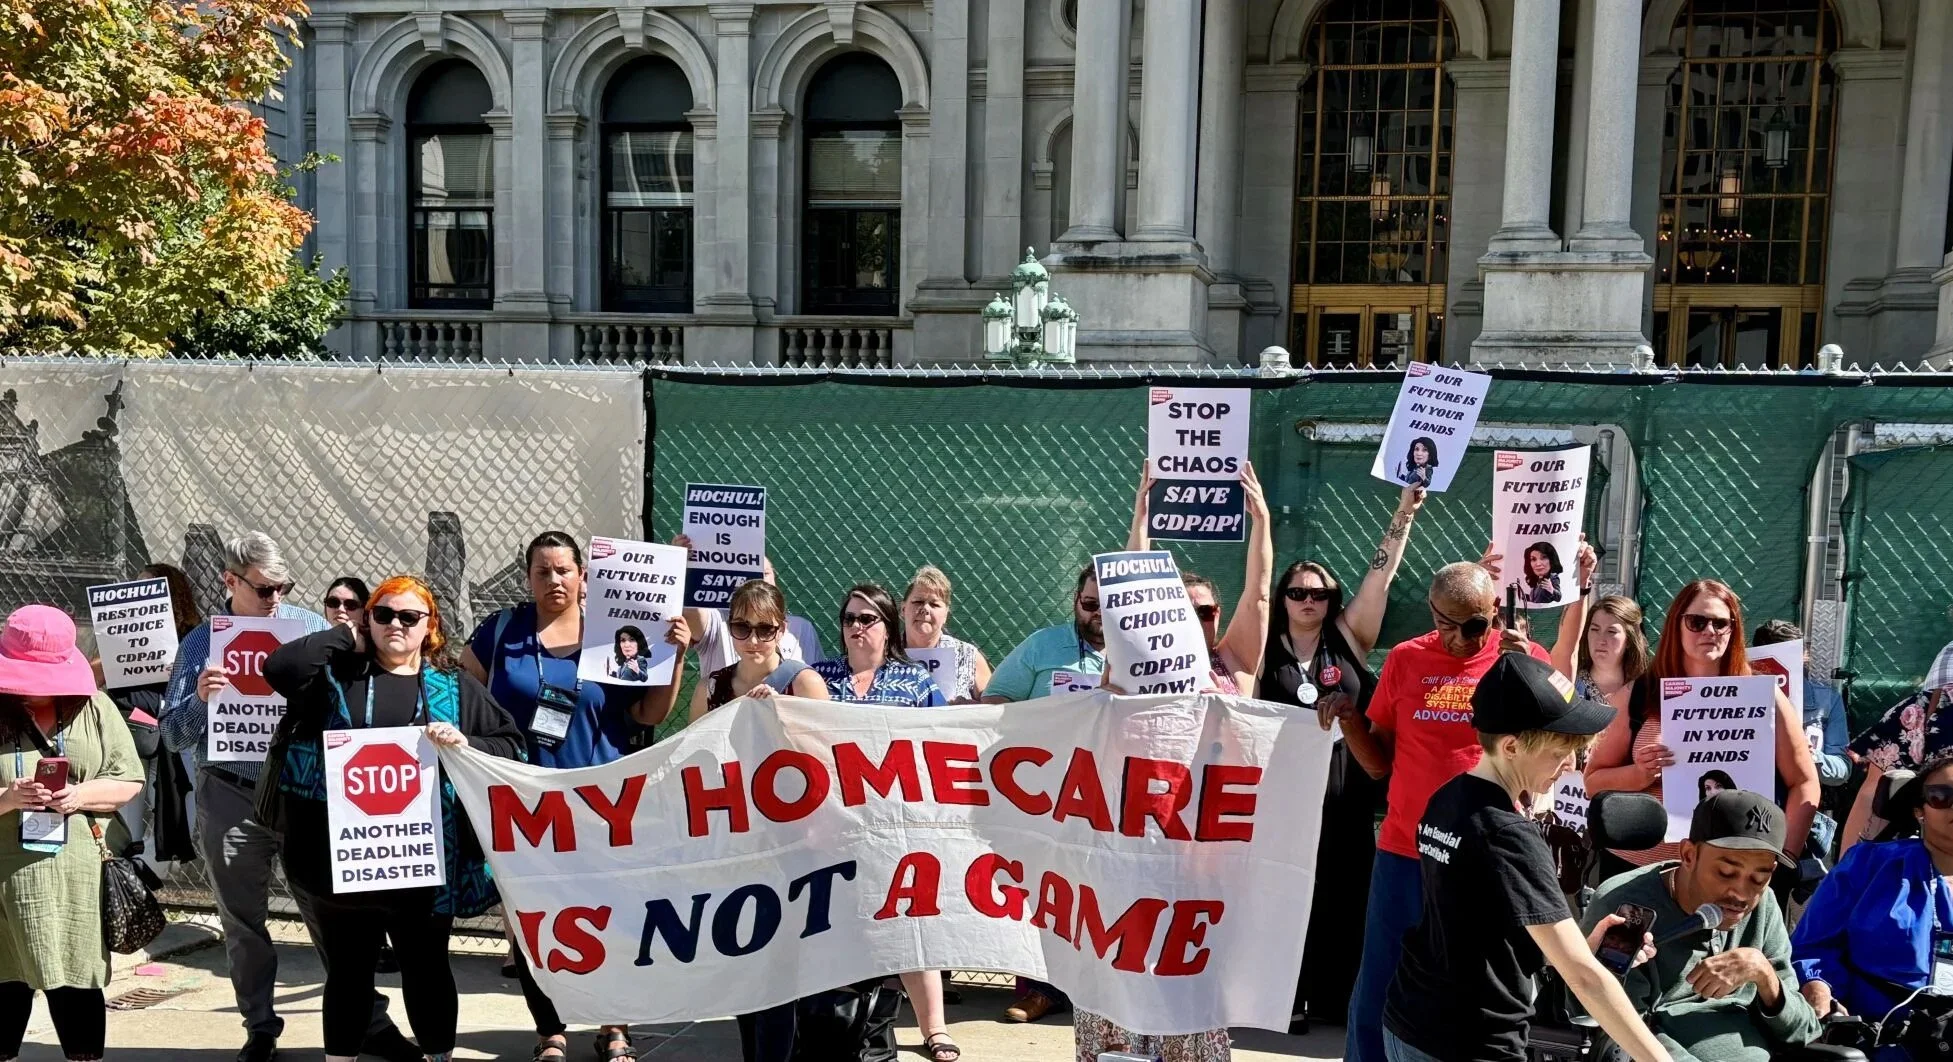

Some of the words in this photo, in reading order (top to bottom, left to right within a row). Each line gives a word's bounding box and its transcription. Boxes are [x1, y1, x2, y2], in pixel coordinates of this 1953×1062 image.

[1434, 373, 1463, 387] OUR
[1407, 385, 1464, 405] FUTURE
[1462, 395, 1478, 406] IS
[1168, 402, 1230, 419] STOP
[1410, 402, 1426, 414] IN
[1428, 407, 1465, 421] YOUR
[1408, 419, 1455, 436] HANDS
[1176, 429, 1221, 446] THE
[1157, 455, 1238, 473] CHAOS
[1531, 459, 1565, 473] OUR
[1502, 479, 1568, 492] FUTURE
[1570, 477, 1582, 489] IS
[689, 489, 764, 506] HOCHUL!
[1163, 486, 1230, 504] SAVE
[1511, 502, 1530, 514] IN
[1534, 499, 1574, 514] YOUR
[689, 511, 760, 528] ENOUGH
[1151, 513, 1242, 532] CDPAP!
[1515, 521, 1570, 535] HANDS
[716, 532, 731, 545] IS
[622, 552, 655, 565] OUR
[689, 550, 760, 566] ENOUGH
[596, 569, 660, 585] FUTURE
[660, 575, 677, 586] IS
[702, 574, 747, 587] SAVE
[92, 583, 166, 603] HOCHUL!
[604, 588, 622, 600] IN
[624, 590, 667, 604] YOUR
[693, 590, 733, 604] CDP
[1106, 586, 1185, 609] RESTORE
[97, 603, 168, 622] RESTORE
[607, 607, 662, 622] HANDS
[1119, 608, 1187, 631] CHOICE
[107, 619, 164, 636] CHOICE
[128, 636, 150, 648] TO
[1148, 633, 1174, 651] TO
[116, 650, 167, 664] CDPAP
[227, 650, 267, 676] STO
[1129, 653, 1197, 677] CDPAP
[123, 663, 164, 676] NOW!
[1138, 676, 1196, 695] NOW!
[1699, 686, 1738, 698] OUR
[1423, 692, 1472, 702] DISABILIT
[1425, 700, 1473, 711] SYSTEMS
[216, 703, 287, 717] ANOTHE
[1412, 709, 1475, 723] ADVOCAT
[1671, 706, 1746, 721] FUTURE
[1747, 706, 1766, 719] IS
[213, 721, 276, 735] DEADLI
[1682, 730, 1703, 743] IN
[1706, 728, 1756, 741] YOUR
[216, 740, 272, 753] DISAS
[1687, 750, 1750, 764] HANDS
[346, 764, 417, 795] STOP
[487, 772, 648, 853] MY
[681, 739, 1263, 842] HOMECARE
[339, 822, 433, 841] ANOTHER
[336, 842, 434, 862] DEADLINE
[341, 863, 436, 883] DISASTER
[515, 905, 612, 975] IS
[634, 860, 857, 967] NOT
[873, 851, 941, 921] A
[964, 853, 1225, 977] GAME
